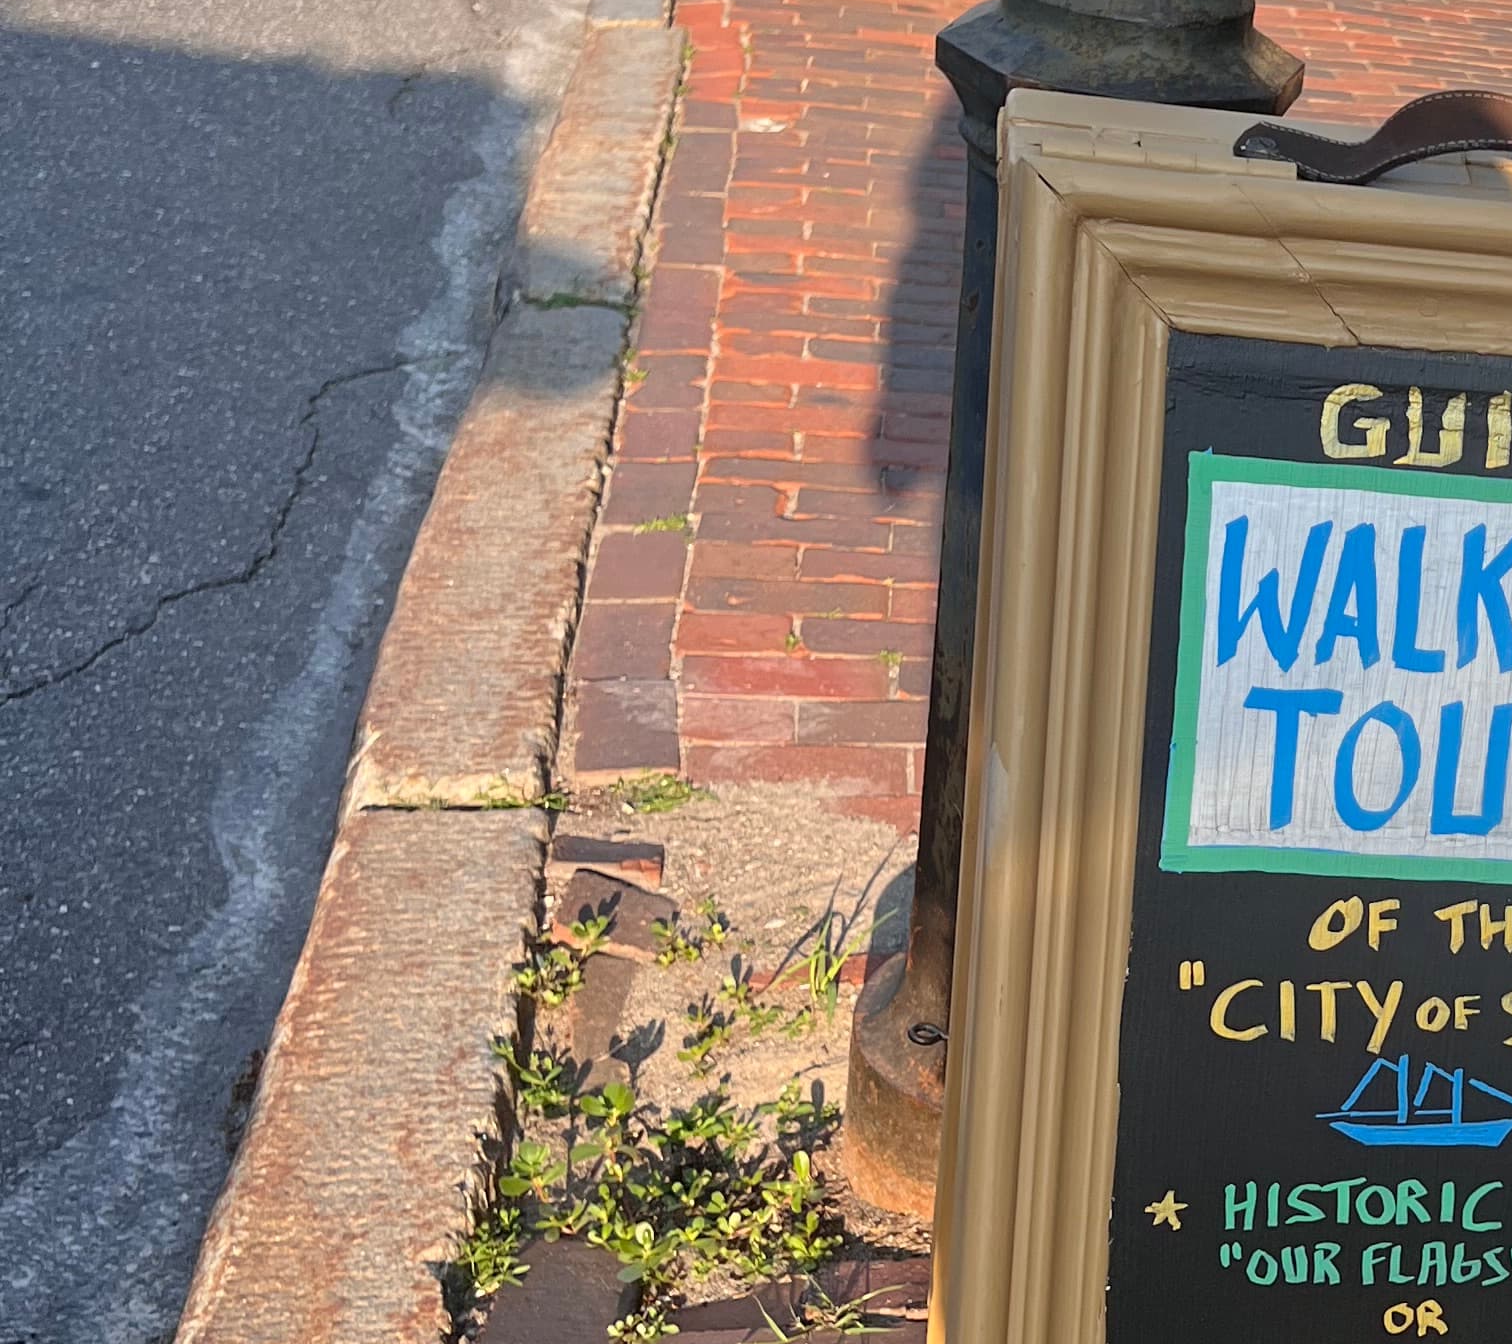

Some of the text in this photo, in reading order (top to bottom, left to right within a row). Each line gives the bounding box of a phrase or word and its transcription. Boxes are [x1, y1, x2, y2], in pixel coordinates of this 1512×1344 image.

[1309, 896, 1399, 951] OF
[1178, 960, 1403, 1054] "CITY
[1415, 994, 1482, 1033] OF
[1224, 1177, 1503, 1232] HISTORIC
[1383, 1300, 1449, 1336] OR
